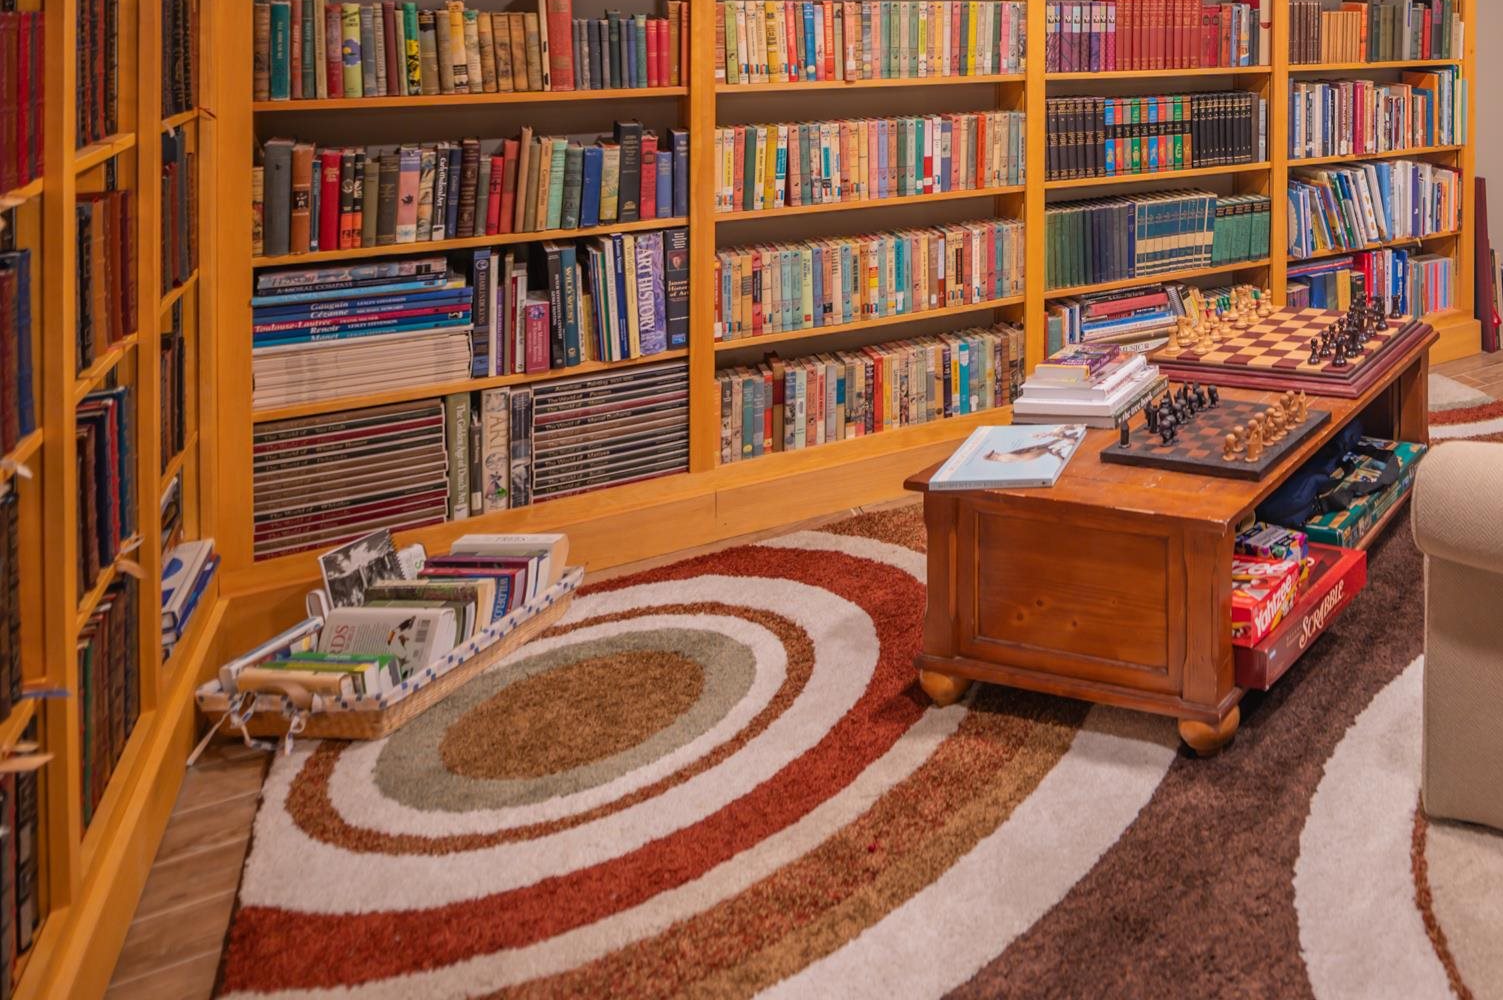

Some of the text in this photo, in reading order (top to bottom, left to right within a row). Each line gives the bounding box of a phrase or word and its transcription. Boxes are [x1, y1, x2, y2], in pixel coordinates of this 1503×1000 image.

[565, 266, 575, 324] WILD WEST
[635, 248, 656, 331] ART HISTORY
[310, 301, 349, 311] Gauguin
[310, 309, 349, 319] Cézanne
[254, 319, 333, 333] Toulouse-Lautrec
[309, 325, 340, 334] Renoir
[310, 332, 340, 342] Manet
[455, 405, 465, 418] The
[456, 419, 466, 445] Golden
[454, 445, 465, 458] Age
[456, 468, 467, 492] Dutch
[457, 492, 466, 504] Art
[1254, 574, 1292, 638] Yahtzee
[1299, 579, 1344, 649] SCRABBLE
